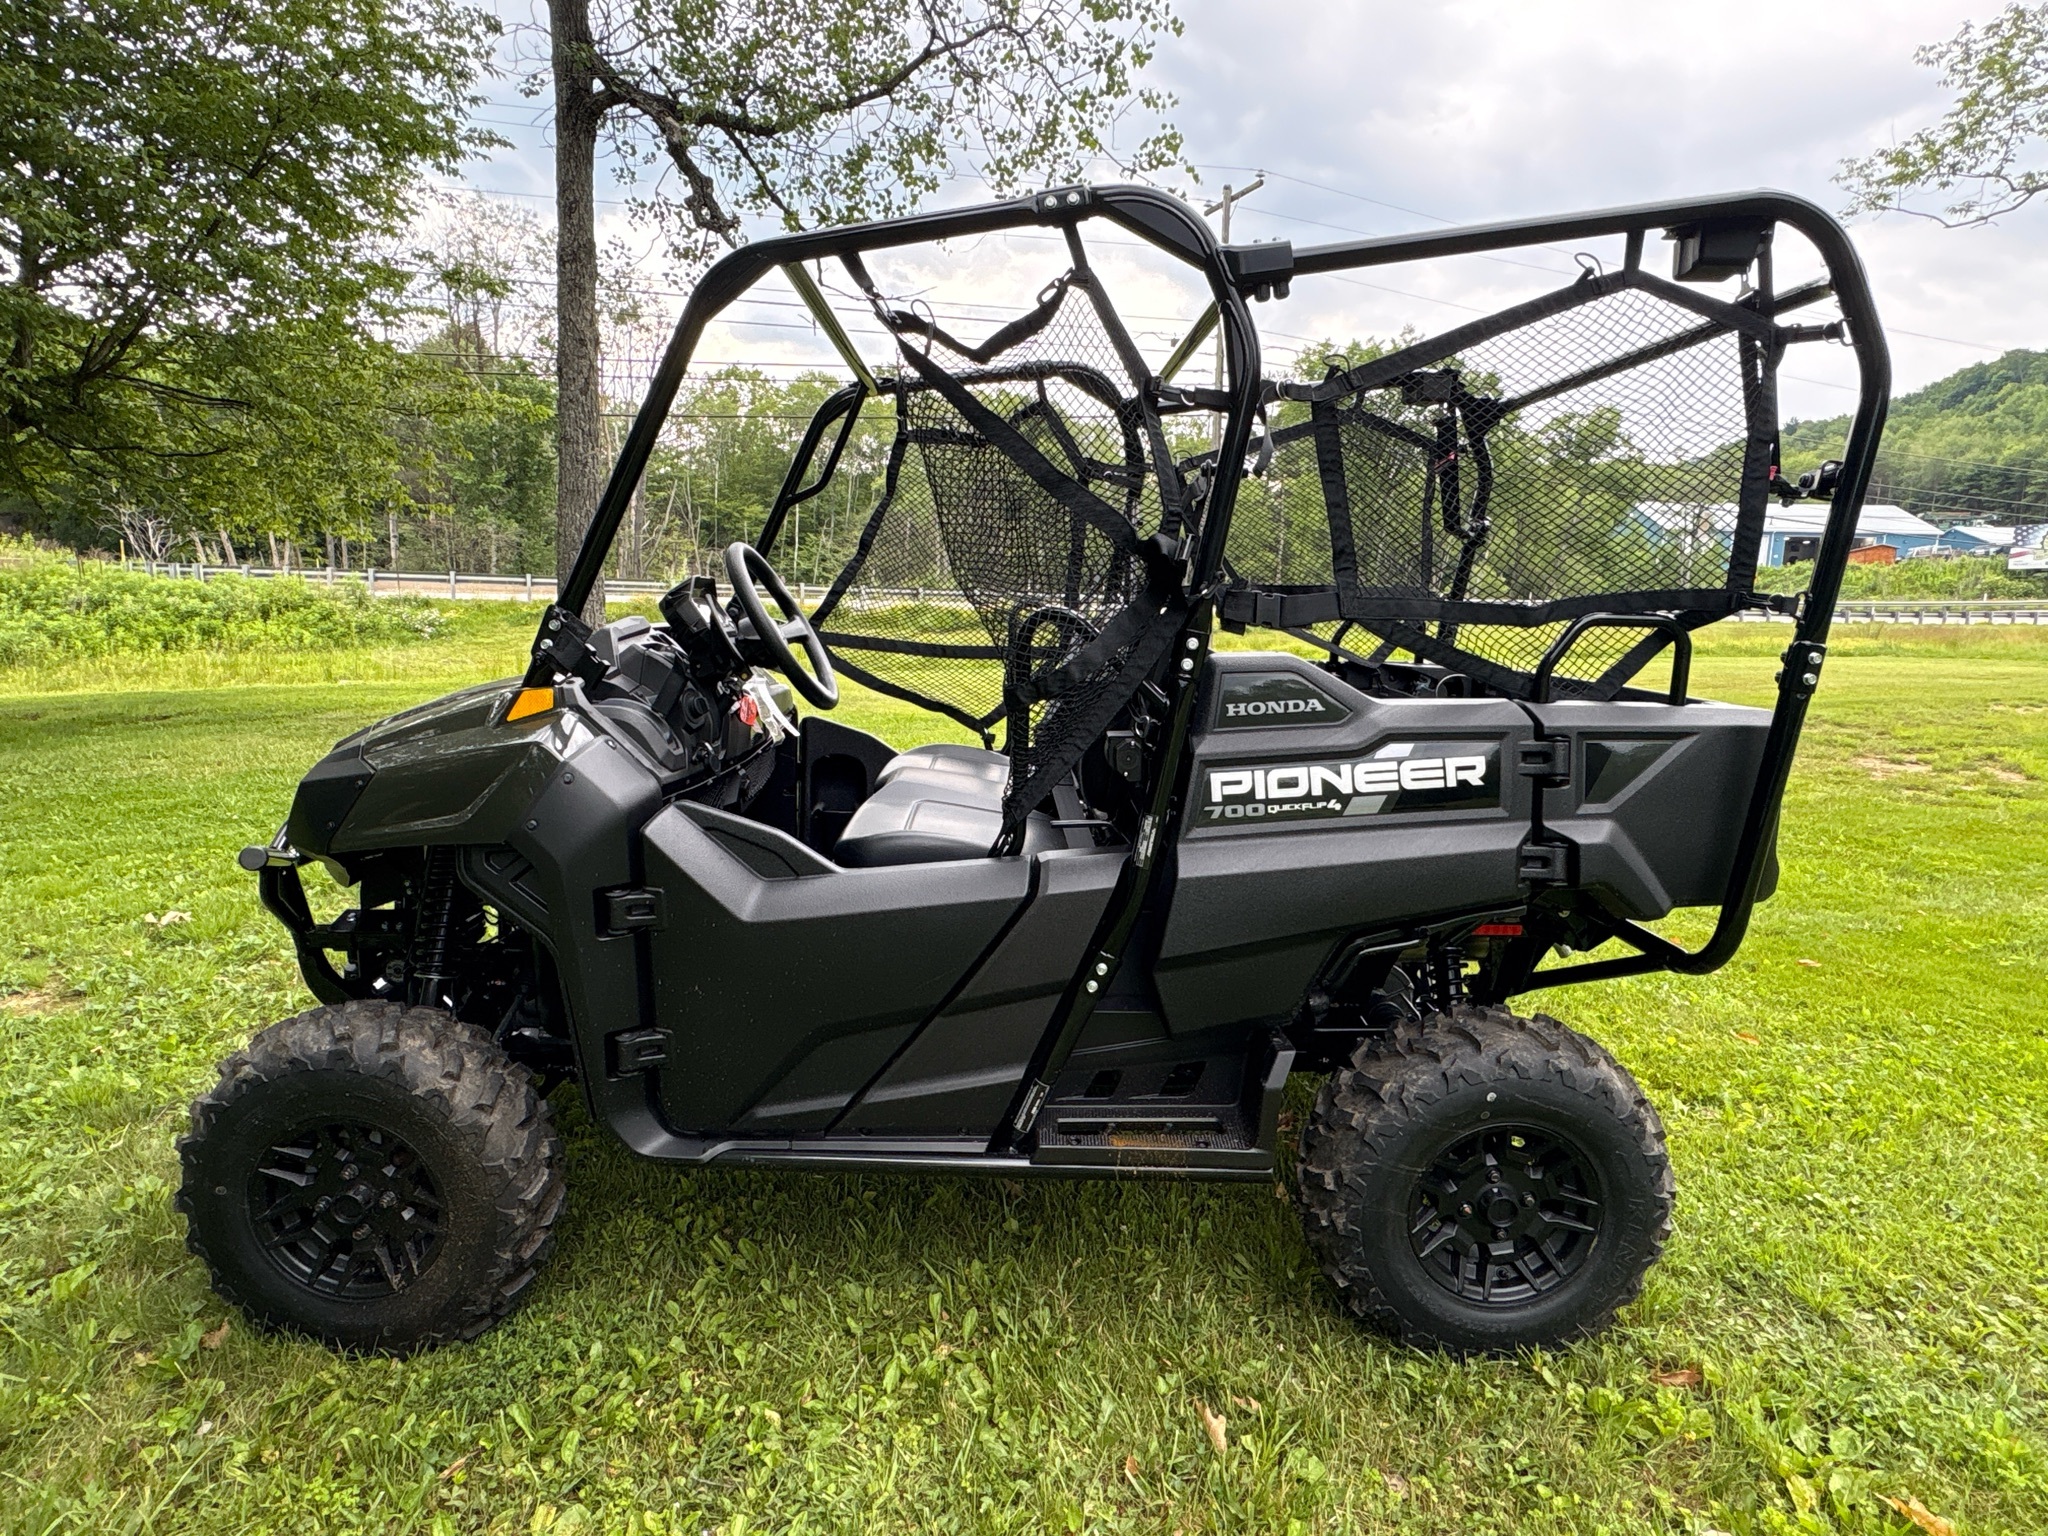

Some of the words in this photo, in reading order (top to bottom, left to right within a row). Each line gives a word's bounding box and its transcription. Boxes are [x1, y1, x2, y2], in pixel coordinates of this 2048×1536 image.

[1225, 698, 1326, 717] HONDA
[1209, 755, 1487, 802] PIONEER
[1204, 803, 1266, 819] 700
